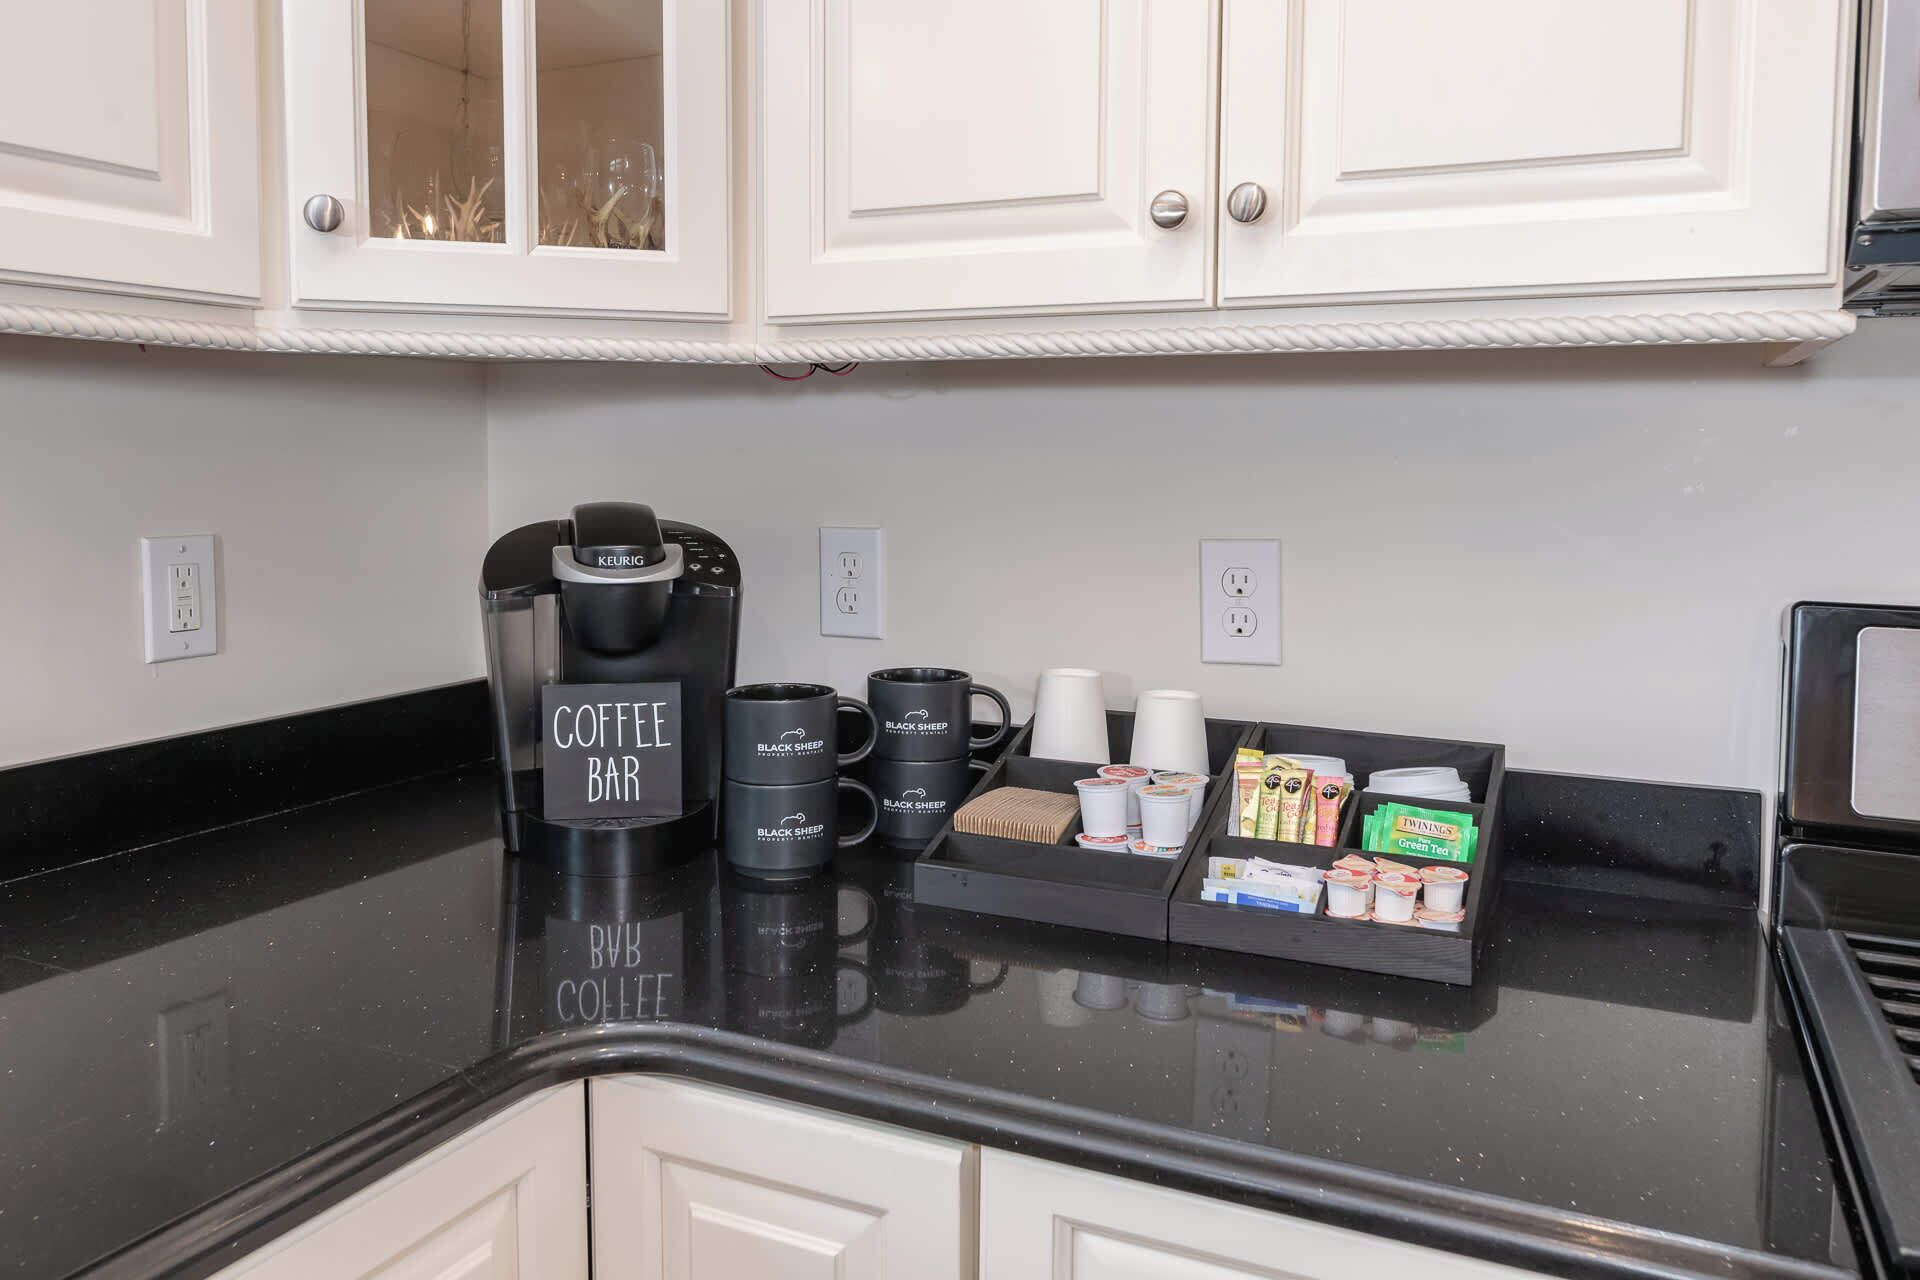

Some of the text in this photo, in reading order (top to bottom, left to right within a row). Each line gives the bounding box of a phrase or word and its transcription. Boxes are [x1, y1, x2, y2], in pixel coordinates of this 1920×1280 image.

[598, 556, 644, 566] KEURIG
[553, 702, 672, 749] COFFEE
[885, 721, 948, 731] BLACK SHEEP
[757, 740, 824, 752] BLACK SHEEP
[587, 755, 640, 802] BAR
[883, 798, 946, 809] BLACK SHEEP
[757, 825, 824, 837] BLACK SHEEP
[1402, 818, 1454, 835] TWININGS
[1398, 839, 1429, 853] Green
[1430, 845, 1449, 856] Tea
